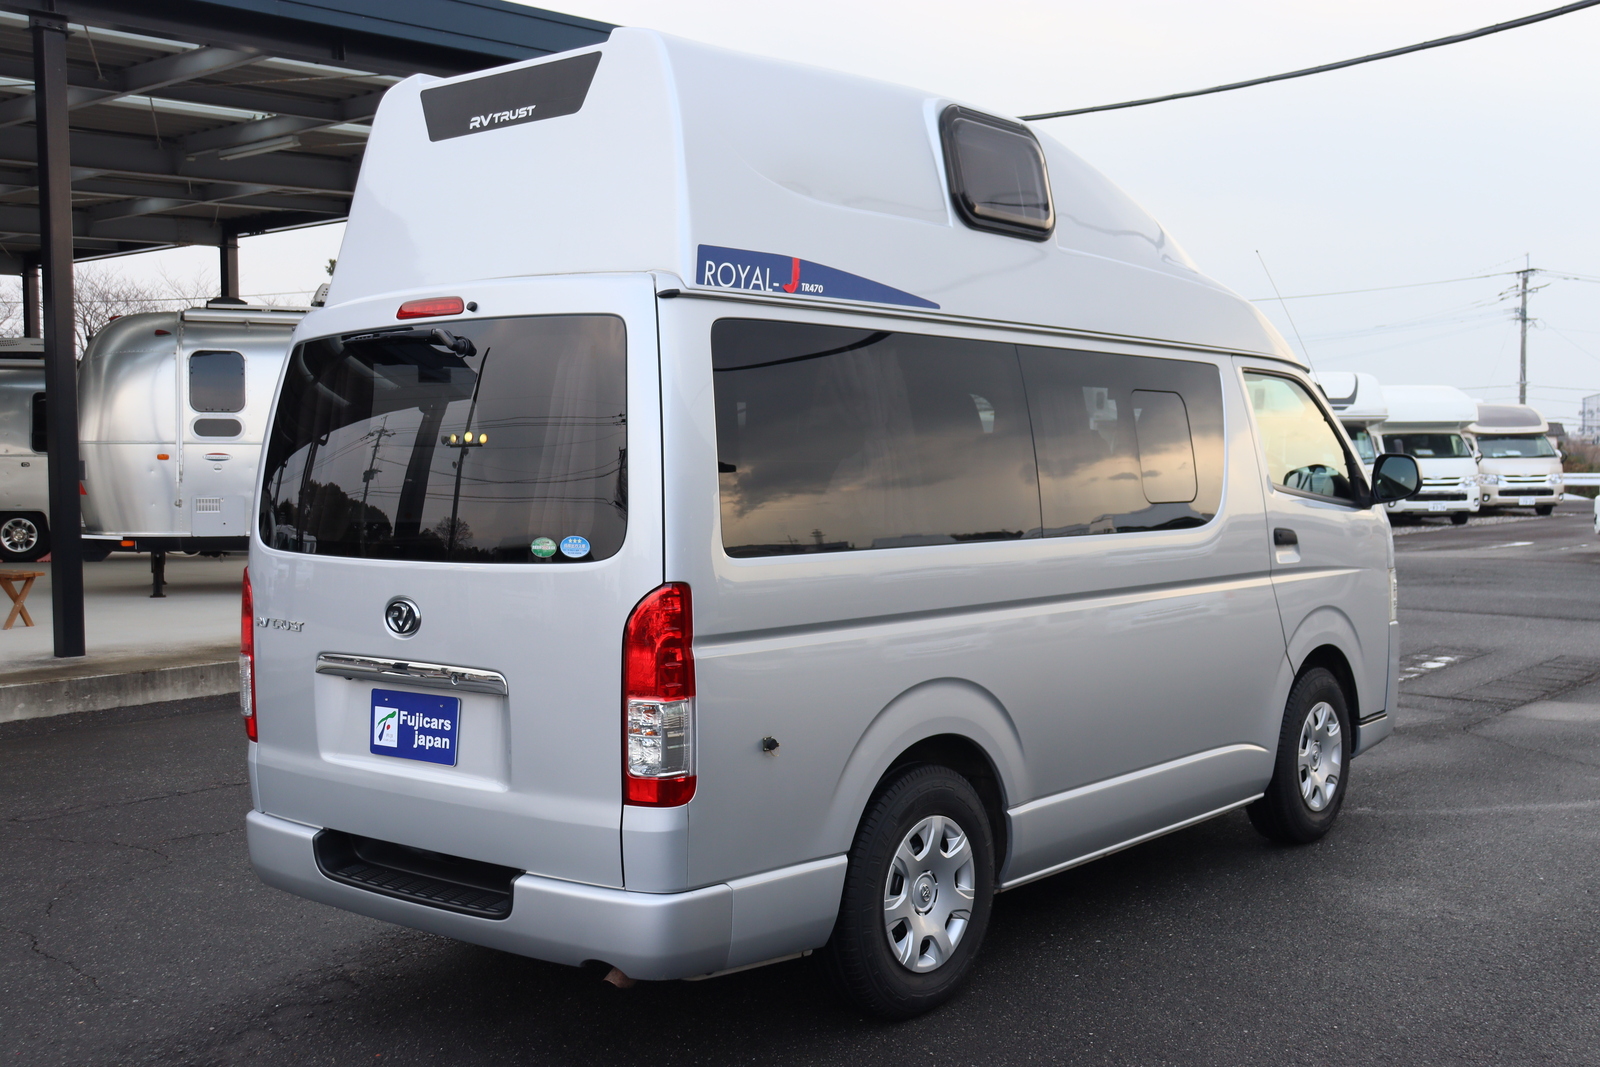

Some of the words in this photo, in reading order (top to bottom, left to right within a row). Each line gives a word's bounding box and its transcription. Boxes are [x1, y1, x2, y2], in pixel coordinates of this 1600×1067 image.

[801, 283, 824, 293] TR470
[399, 710, 452, 731] Fujicars
[412, 730, 450, 750] japan
